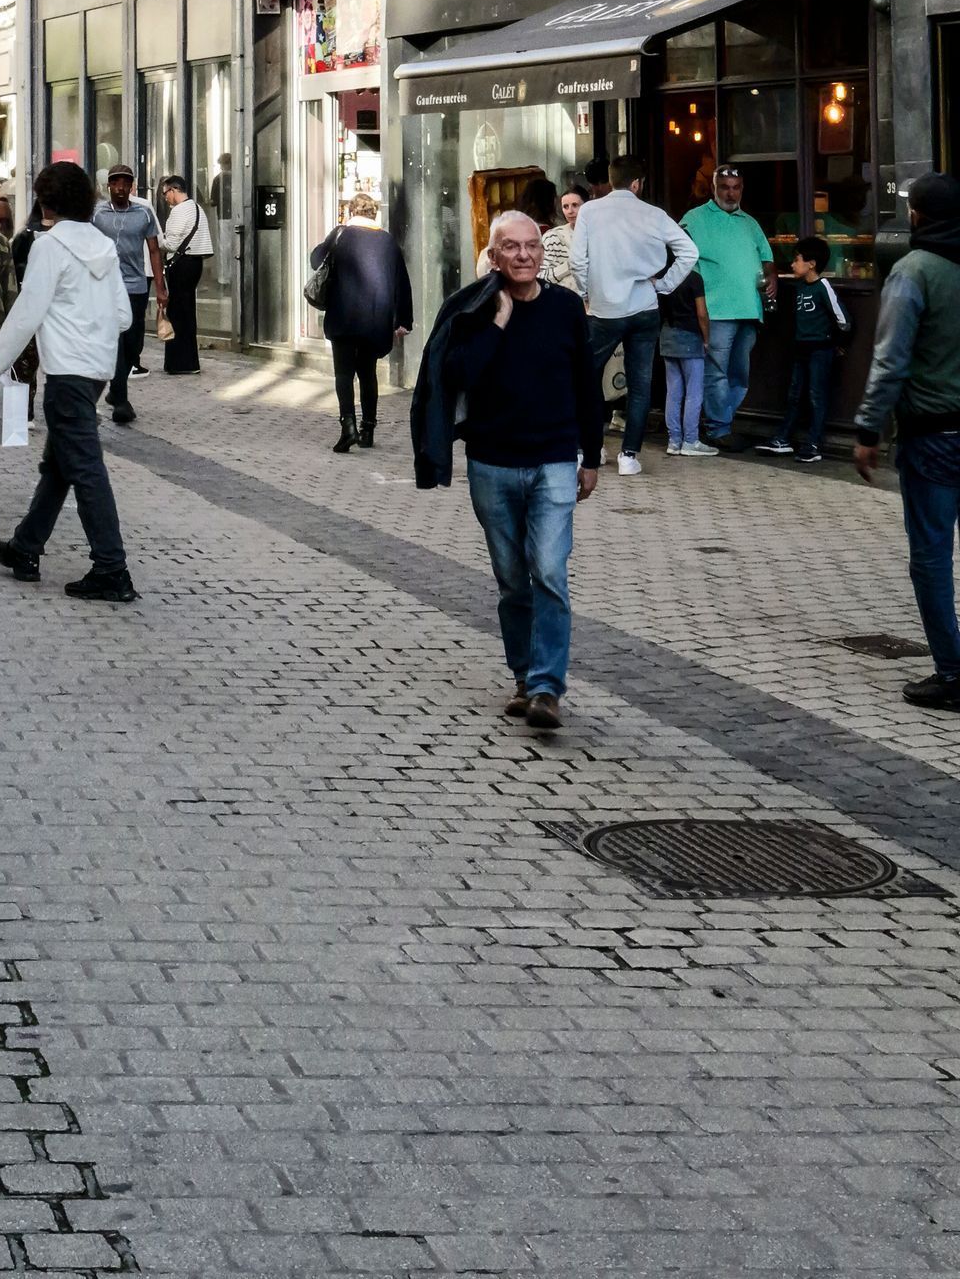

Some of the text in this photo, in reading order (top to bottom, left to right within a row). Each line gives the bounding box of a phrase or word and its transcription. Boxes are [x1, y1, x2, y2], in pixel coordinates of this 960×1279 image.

[557, 78, 614, 95] Gaufres salées
[416, 94, 442, 106] Gaufres
[886, 182, 896, 194] 39
[265, 203, 277, 216] 35
